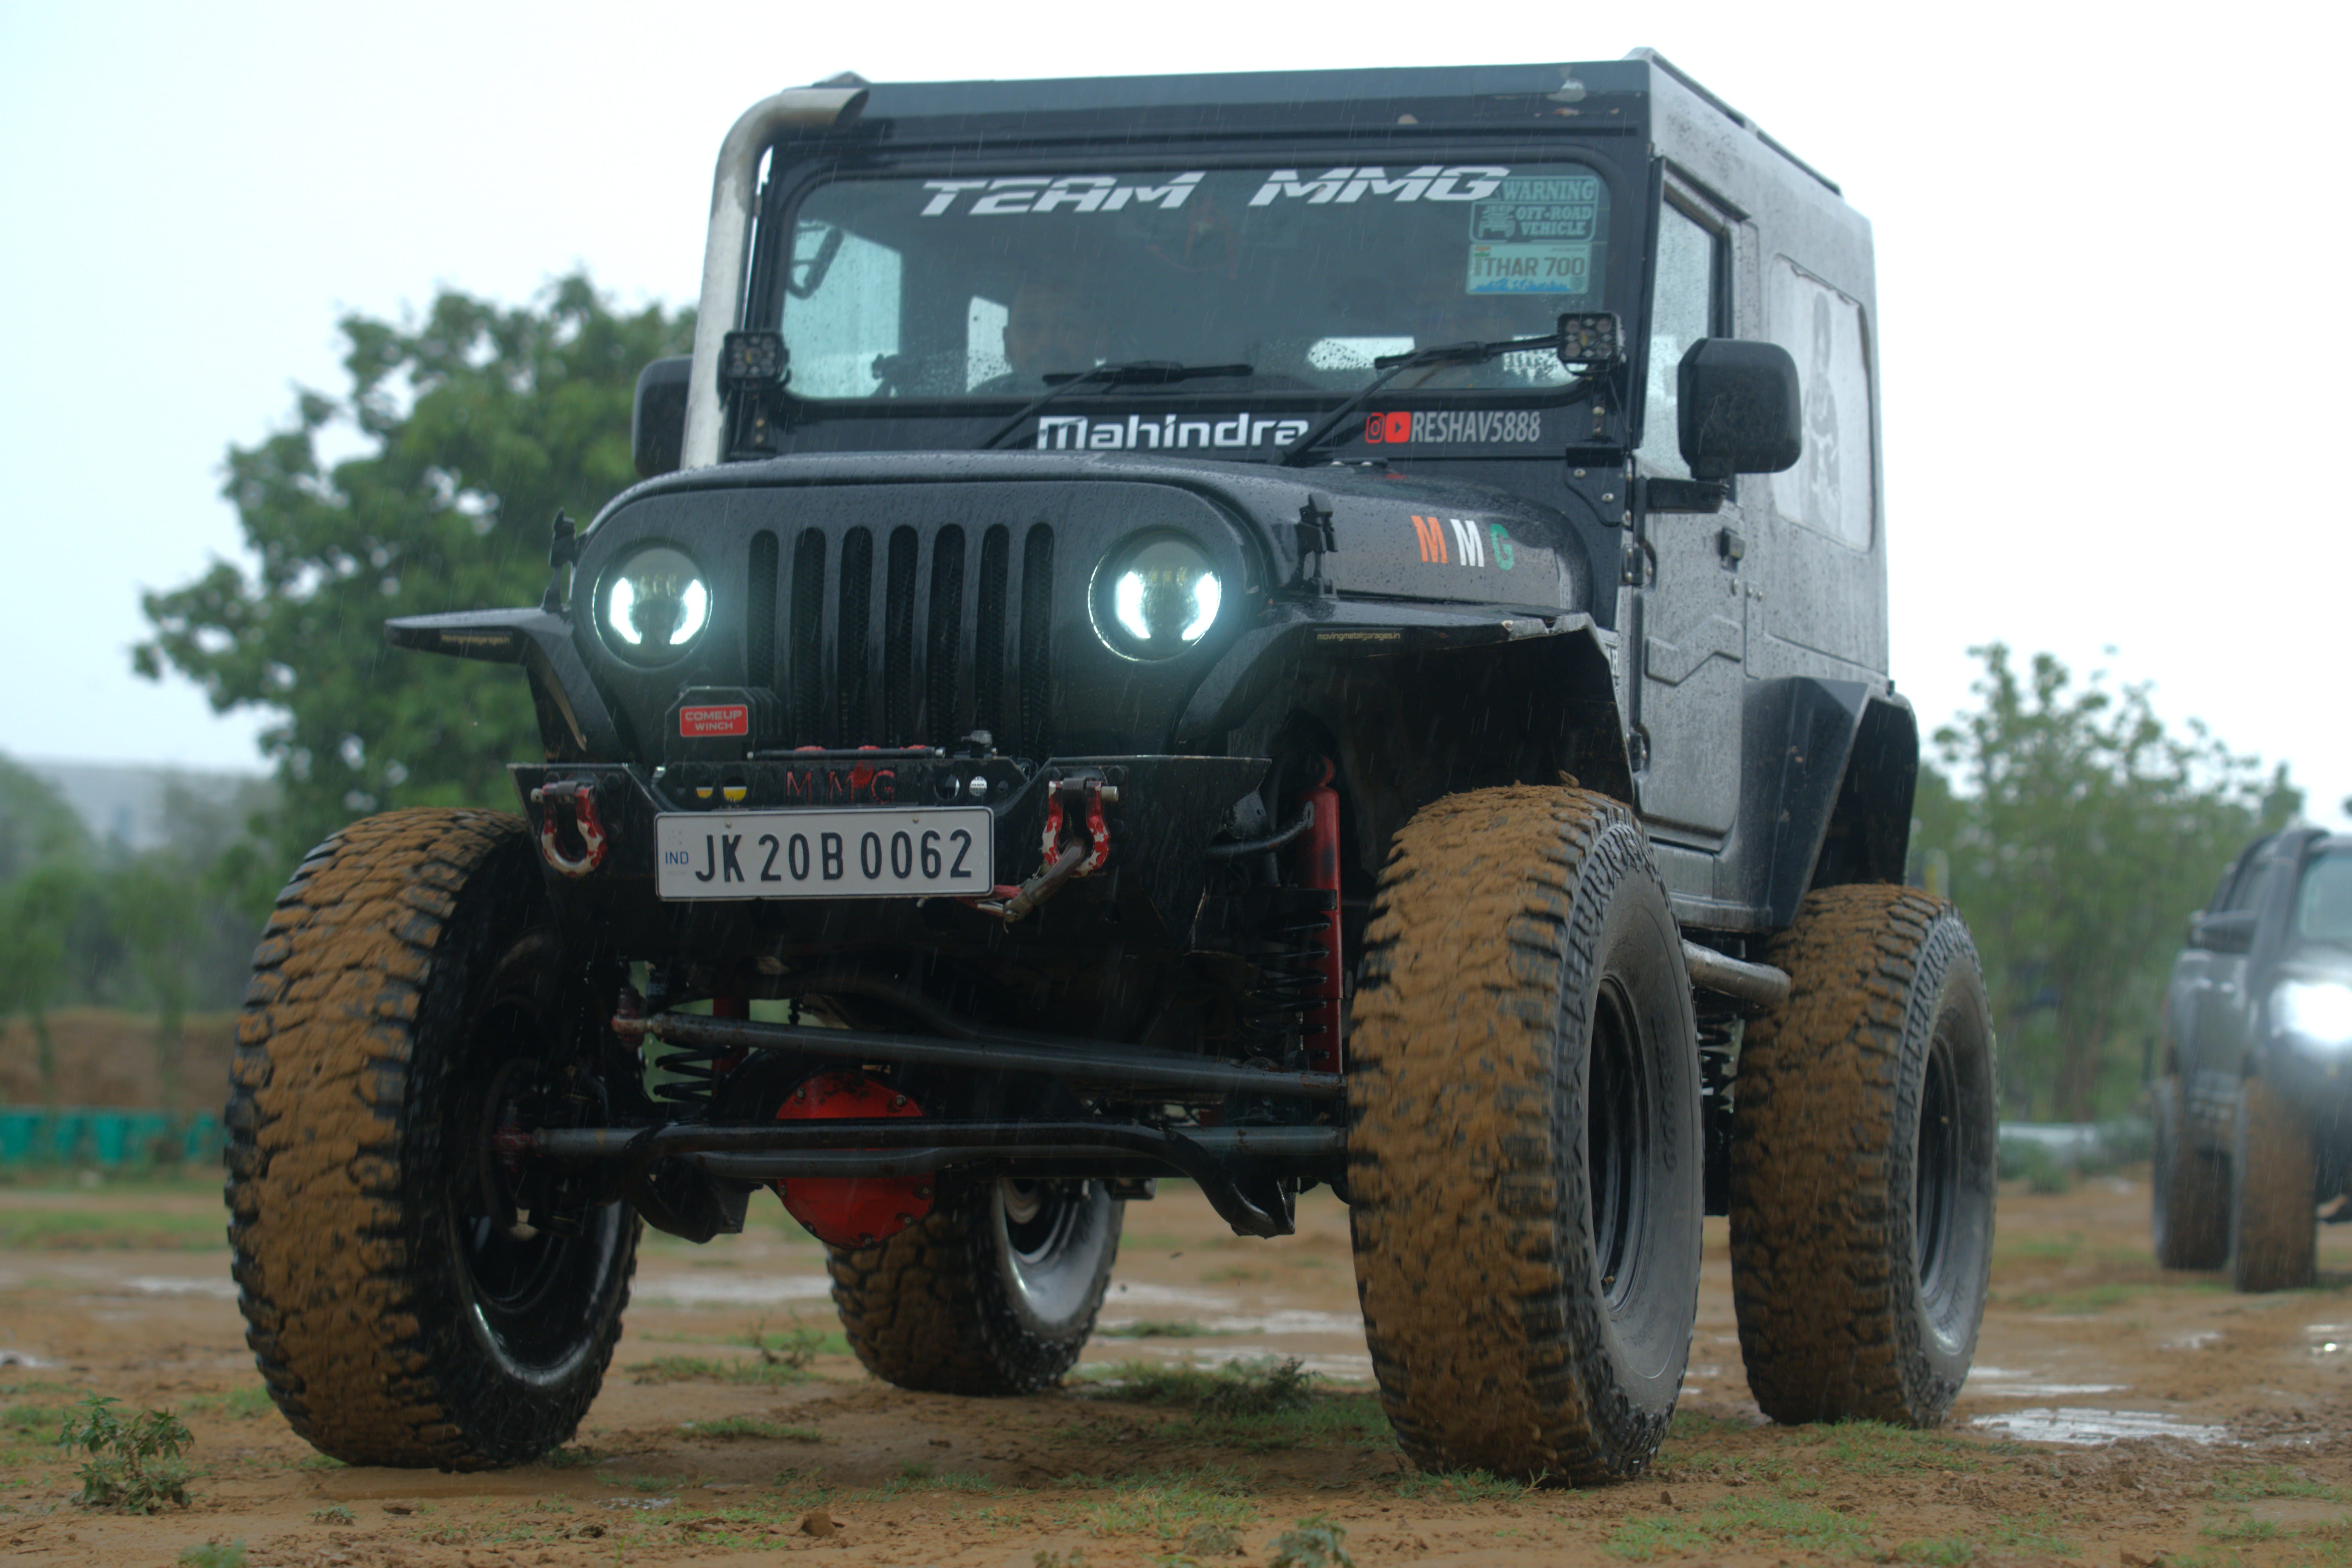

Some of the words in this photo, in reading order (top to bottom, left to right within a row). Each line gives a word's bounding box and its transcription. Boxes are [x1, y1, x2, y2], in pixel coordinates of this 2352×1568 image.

[921, 172, 1205, 216] TEAM
[1248, 166, 1510, 206] MMG
[1502, 179, 1595, 201] WARNING
[1520, 221, 1586, 236] VEHICLE
[1484, 257, 1539, 277] THAR
[1544, 257, 1585, 277] 700
[1410, 411, 1541, 442] RESHAV5888
[685, 710, 742, 721] COMEUP
[695, 721, 733, 731] WINCH
[665, 851, 689, 865] IND
